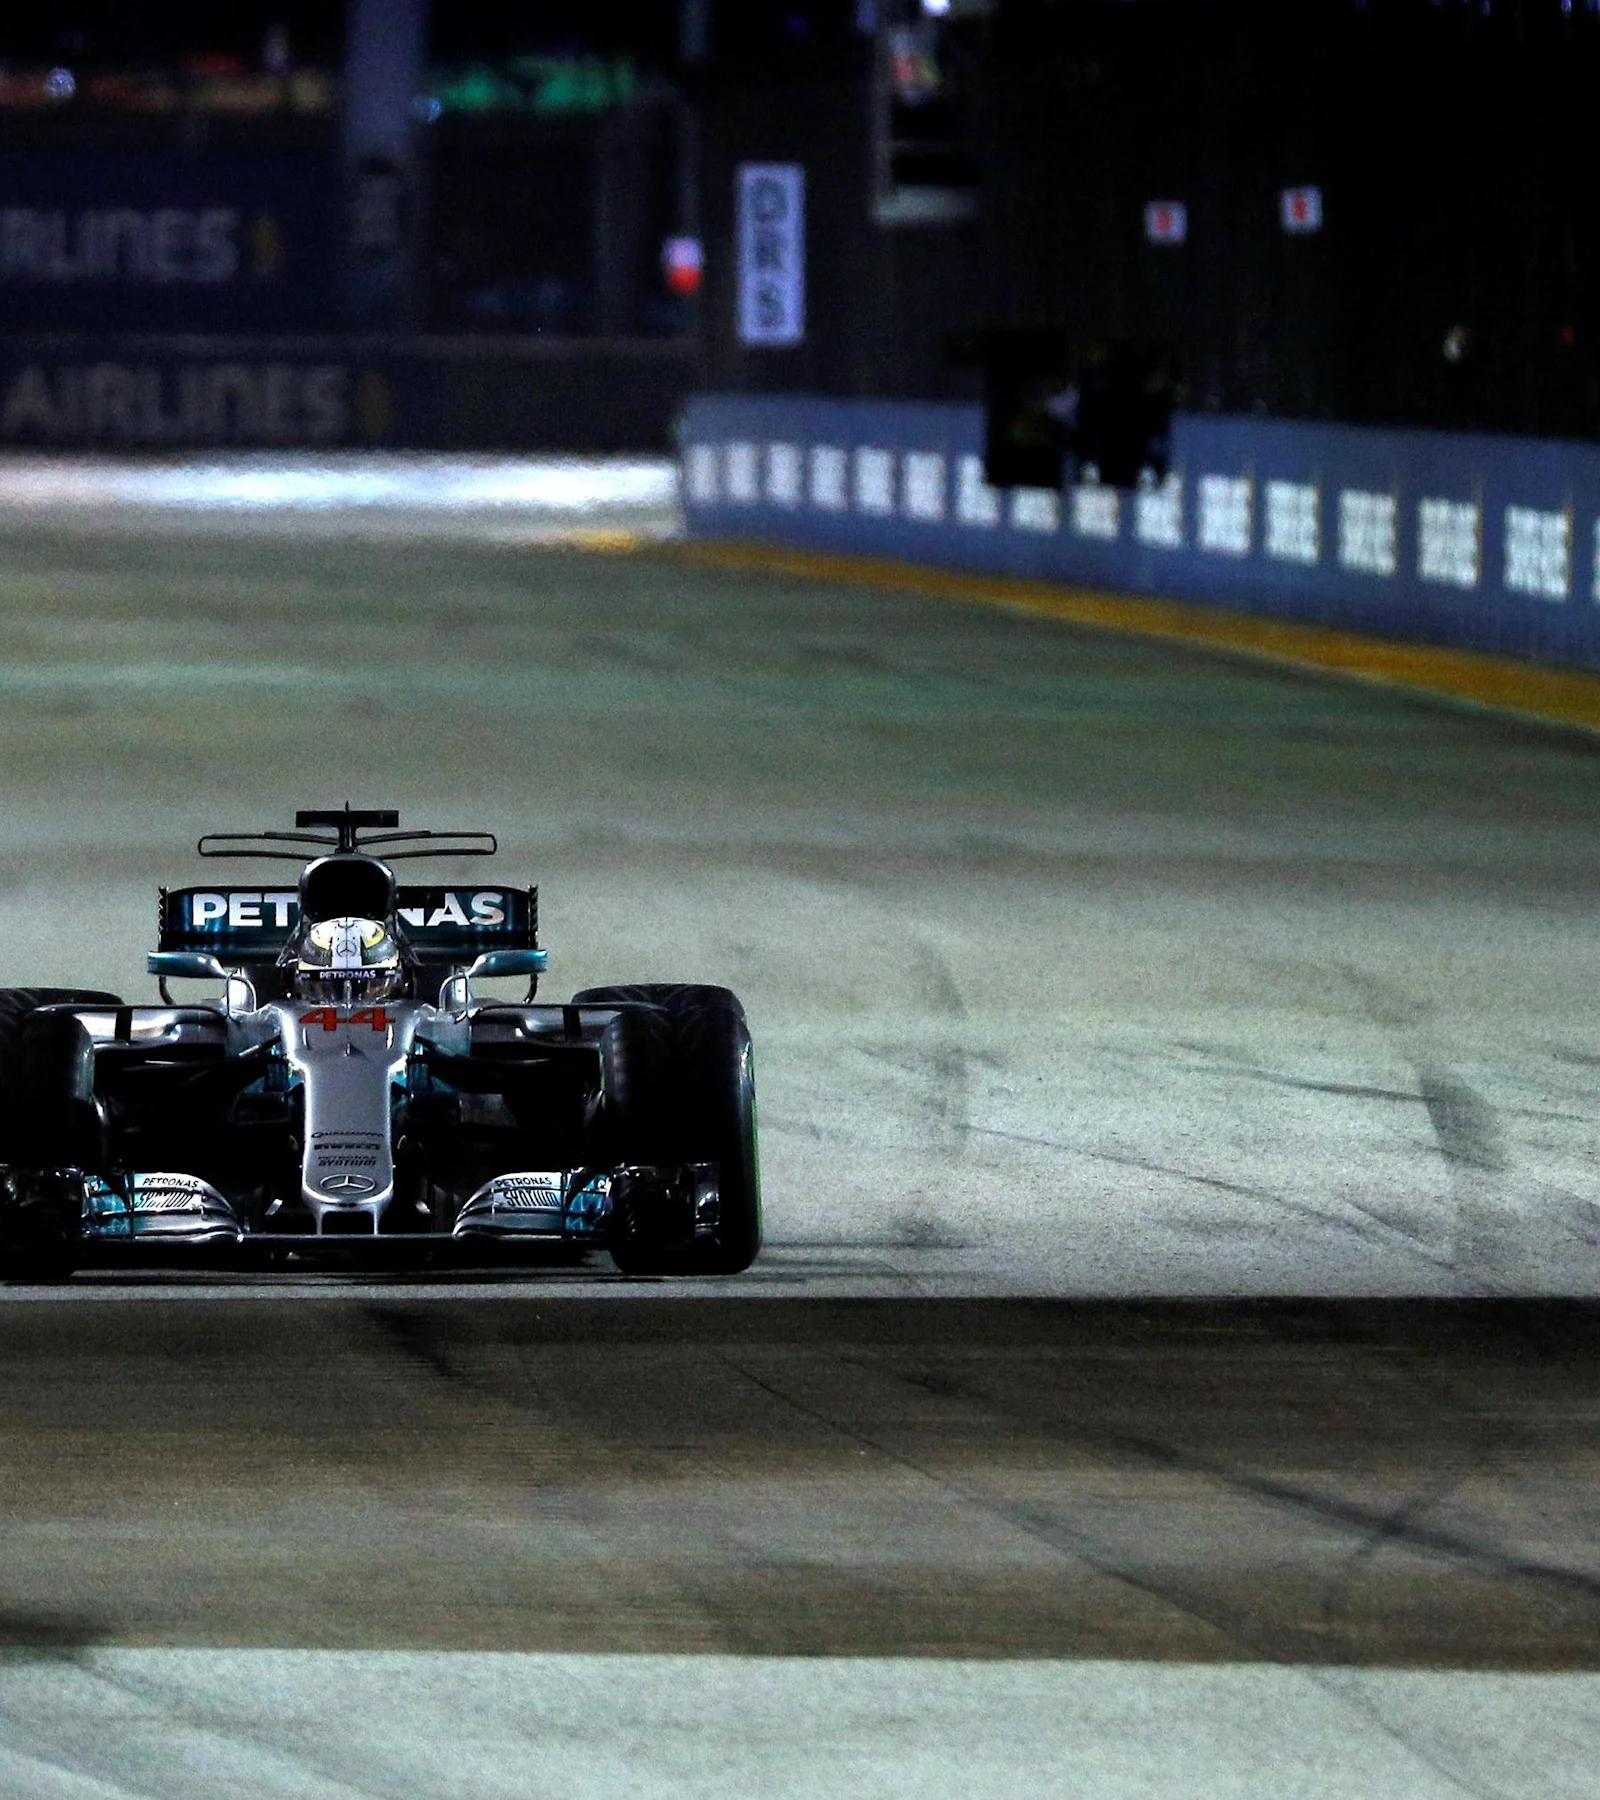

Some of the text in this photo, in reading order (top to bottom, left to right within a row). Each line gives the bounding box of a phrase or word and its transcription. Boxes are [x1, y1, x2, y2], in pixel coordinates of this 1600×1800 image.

[193, 892, 505, 927] PETAS
[319, 969, 377, 980] PETRONAS
[299, 1007, 396, 1032] 44
[142, 1177, 199, 1189] PETRONAS
[494, 1176, 552, 1188] PETRONAS
